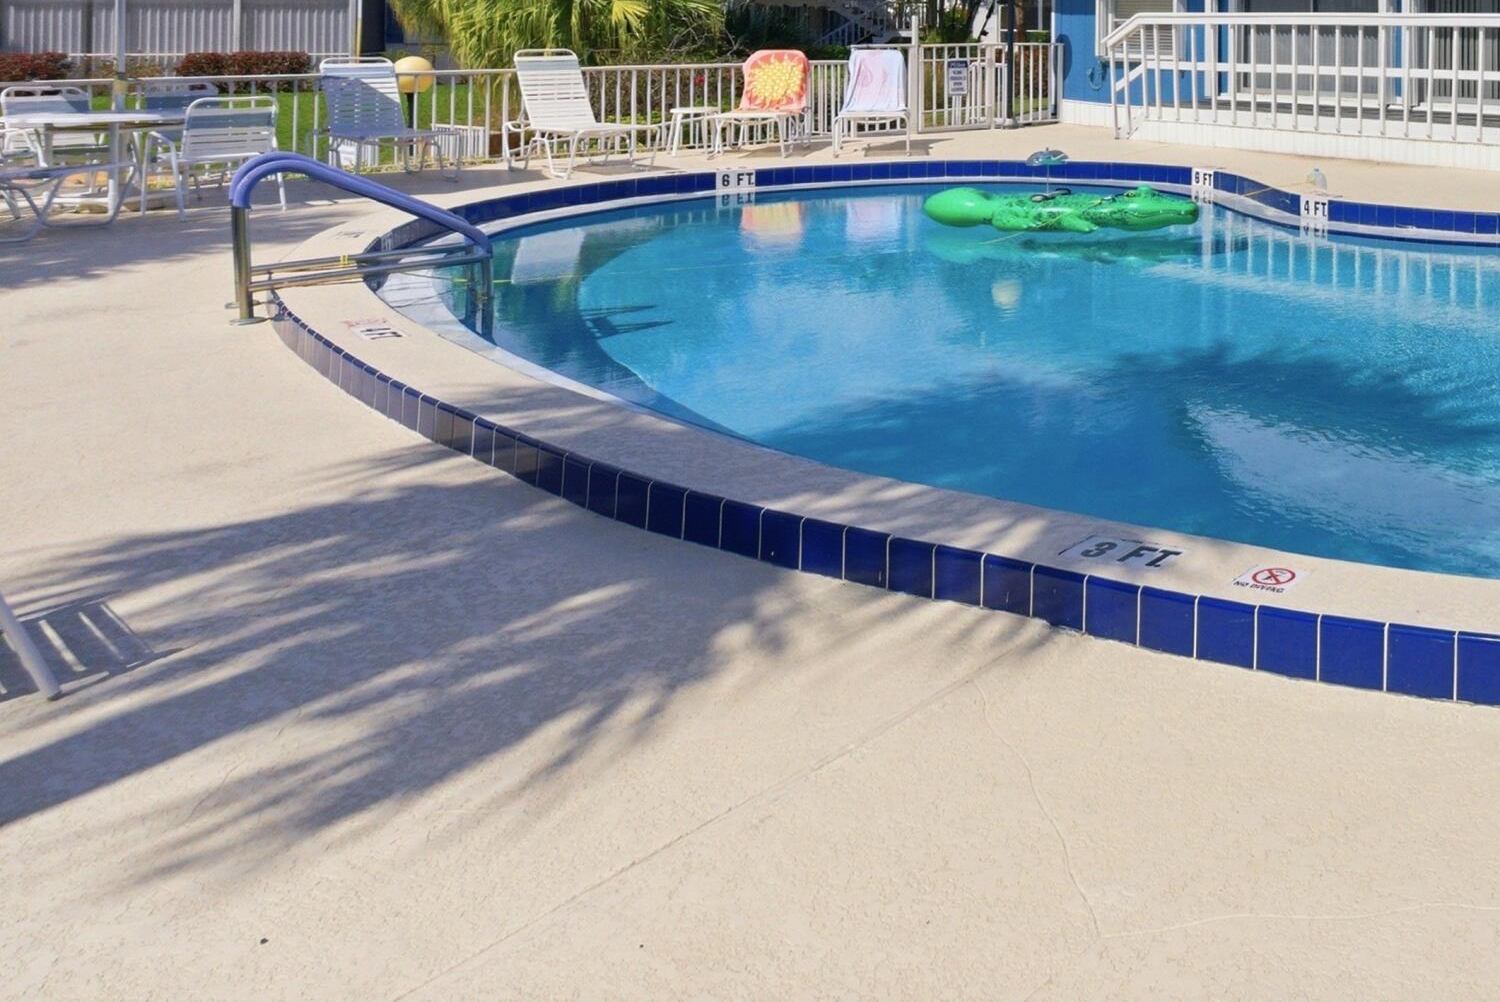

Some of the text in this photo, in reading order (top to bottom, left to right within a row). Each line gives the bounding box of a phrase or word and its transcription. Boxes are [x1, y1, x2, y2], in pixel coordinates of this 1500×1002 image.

[721, 173, 730, 187] 6
[1304, 199, 1310, 214] 4
[1080, 541, 1118, 558] 3
[1250, 583, 1285, 594] DIVING
